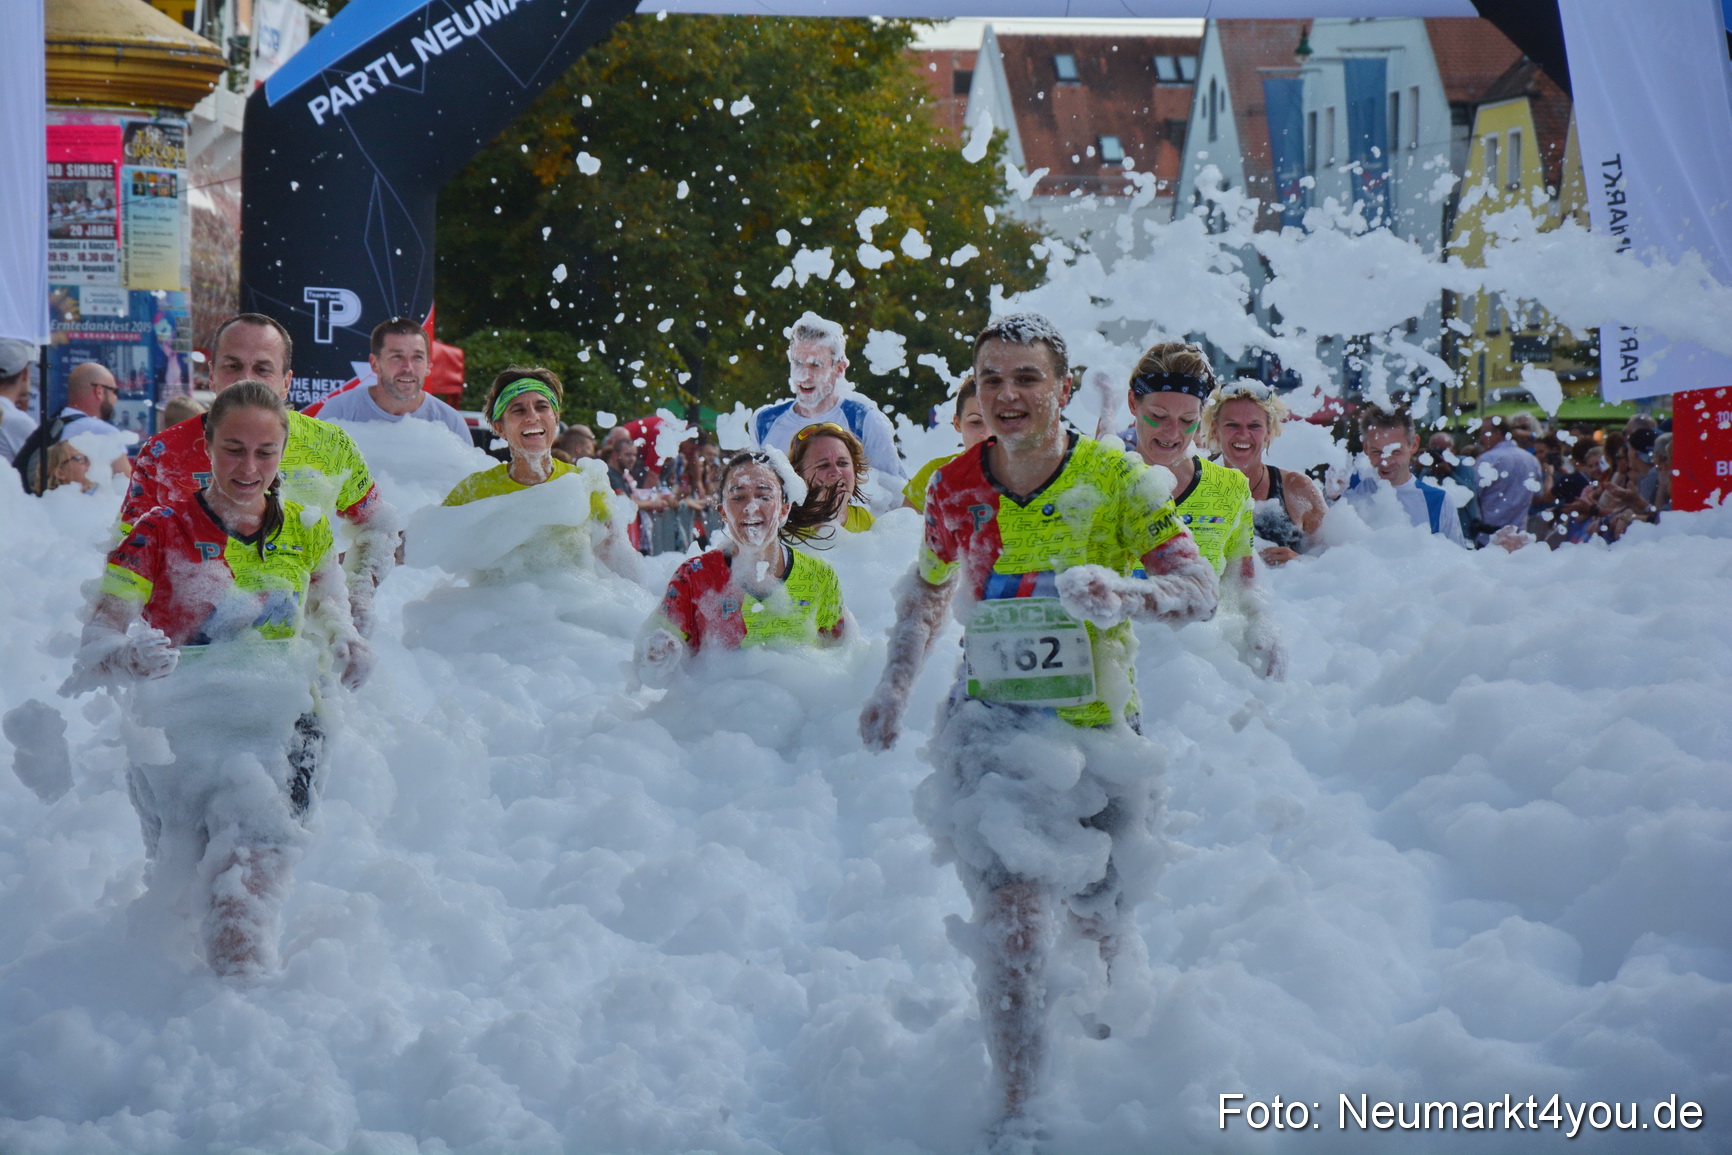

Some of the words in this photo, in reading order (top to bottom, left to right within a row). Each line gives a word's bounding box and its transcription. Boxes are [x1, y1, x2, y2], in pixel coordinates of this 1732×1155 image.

[307, 51, 415, 126] PARTL
[66, 163, 113, 178] SUNRISE
[69, 224, 83, 236] 20
[85, 224, 115, 237] JAHRE
[49, 319, 131, 333] Erntedankfest
[311, 378, 347, 391] NEXT
[989, 635, 1064, 673] 162
